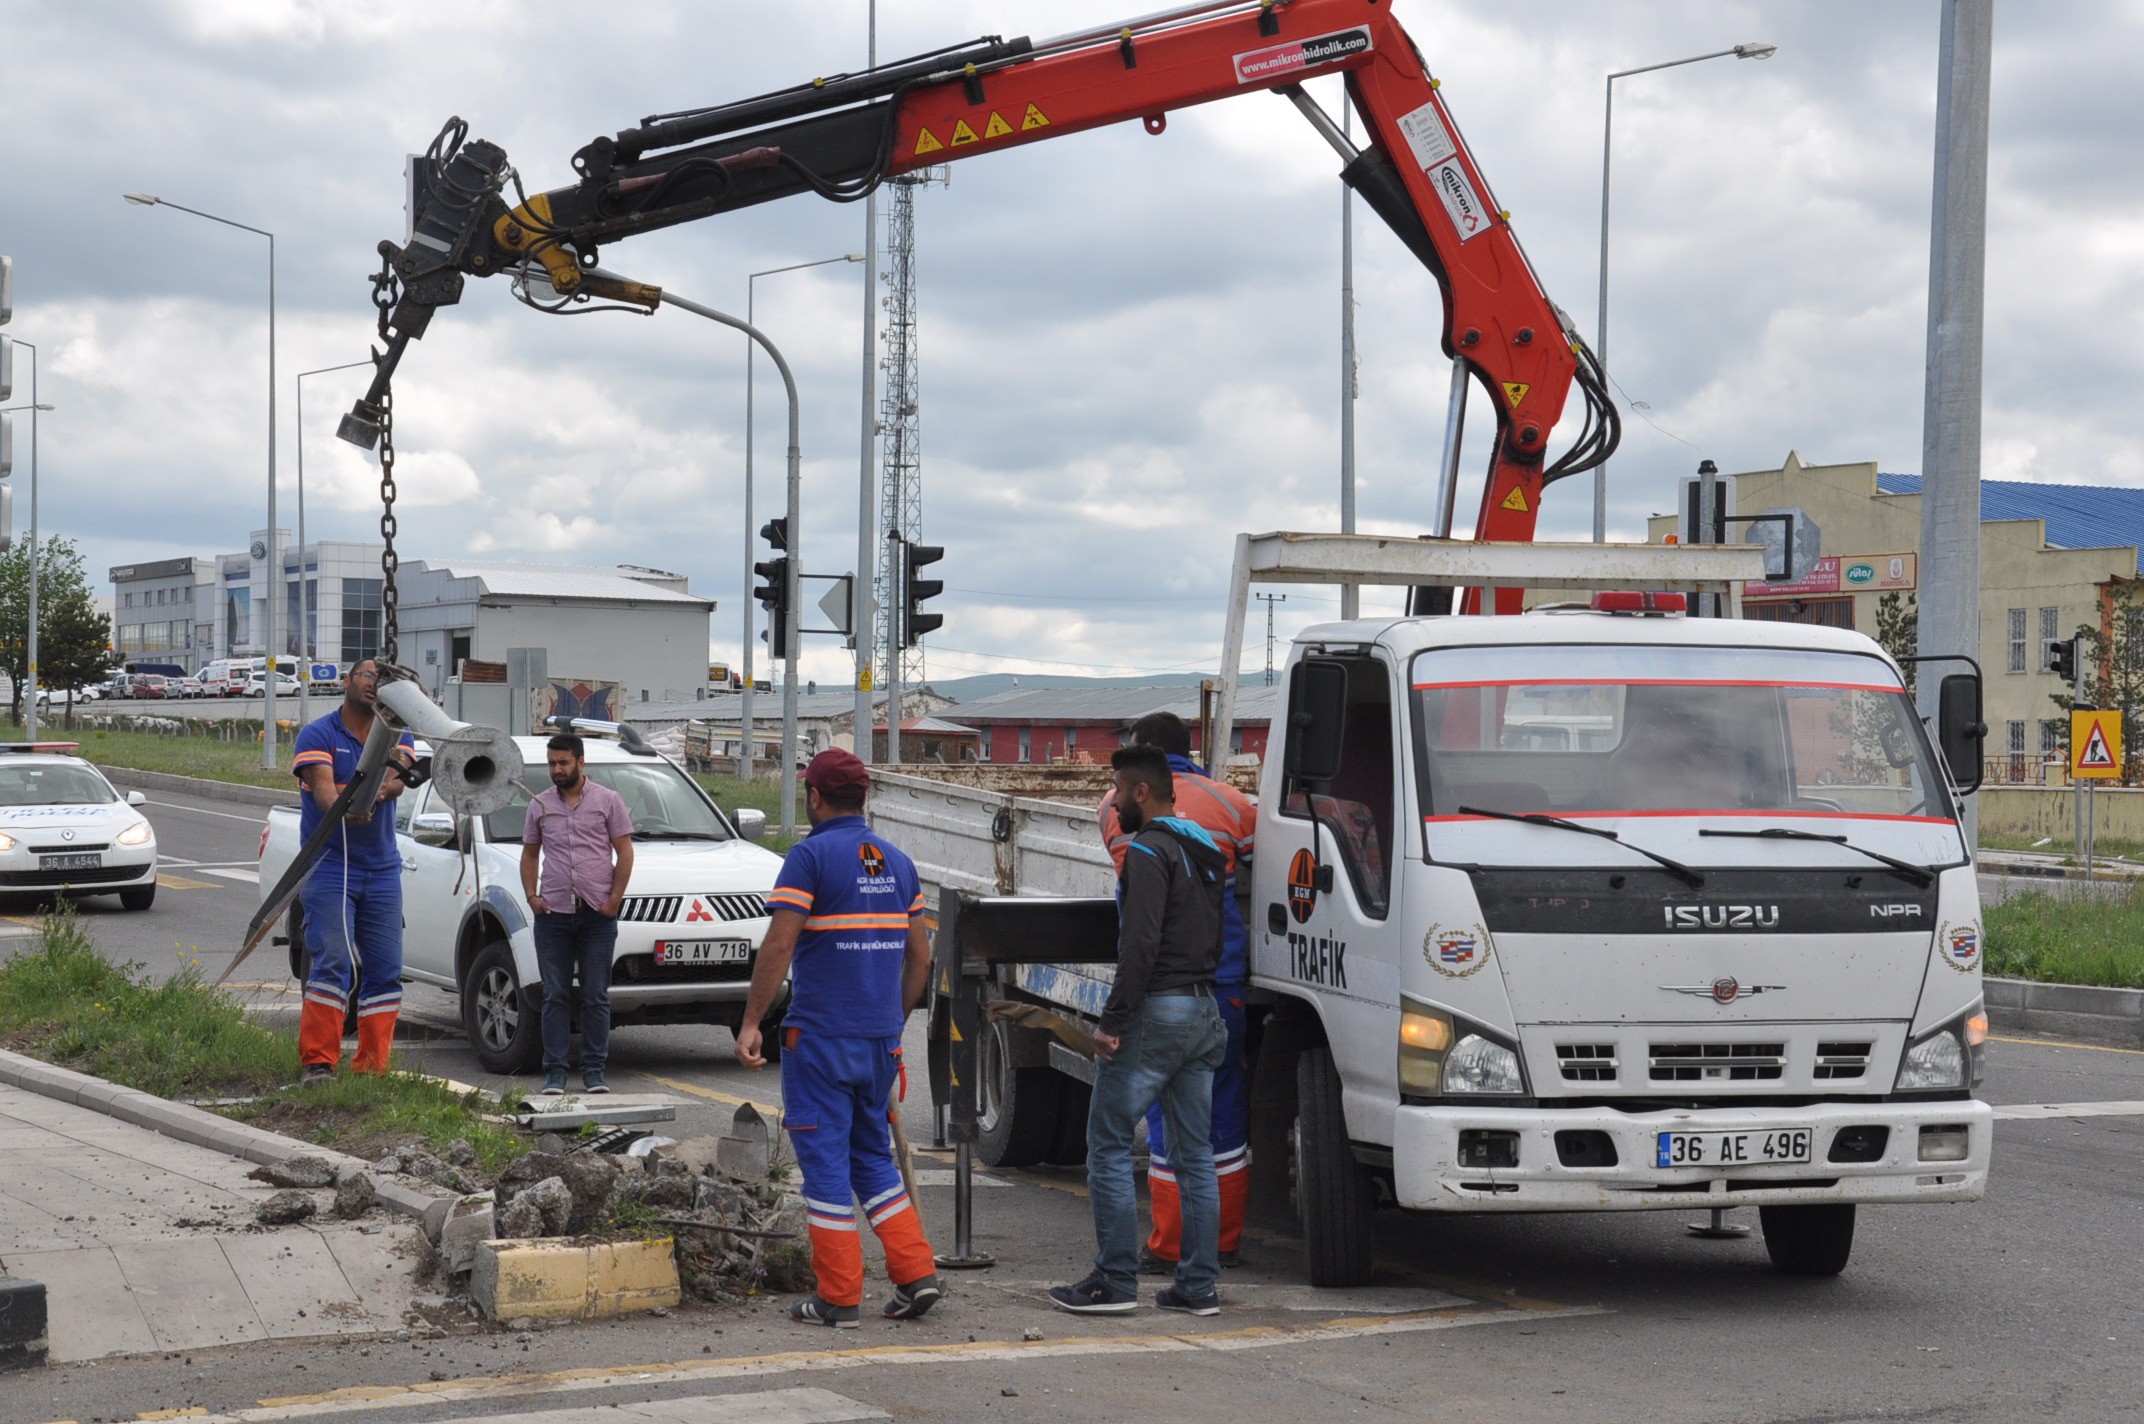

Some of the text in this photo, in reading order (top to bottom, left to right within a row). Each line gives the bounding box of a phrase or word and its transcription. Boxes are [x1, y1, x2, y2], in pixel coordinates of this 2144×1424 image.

[1242, 37, 1366, 74] www.mikronhidrolik.com
[1444, 170, 1471, 214] mikron
[1448, 192, 1464, 217] hidrolik
[46, 855, 99, 867] 36 A 4544
[1294, 886, 1310, 899] KGM
[1664, 905, 1779, 929] ISUZU
[1870, 903, 1922, 918] NPR
[665, 943, 683, 959] 36
[693, 943, 711, 959] AV
[720, 942, 748, 959] 718
[835, 940, 861, 950] TRAFİK
[1288, 928, 1347, 989] TRAFİK
[1659, 1132, 1807, 1162] TR 36 AE 496
